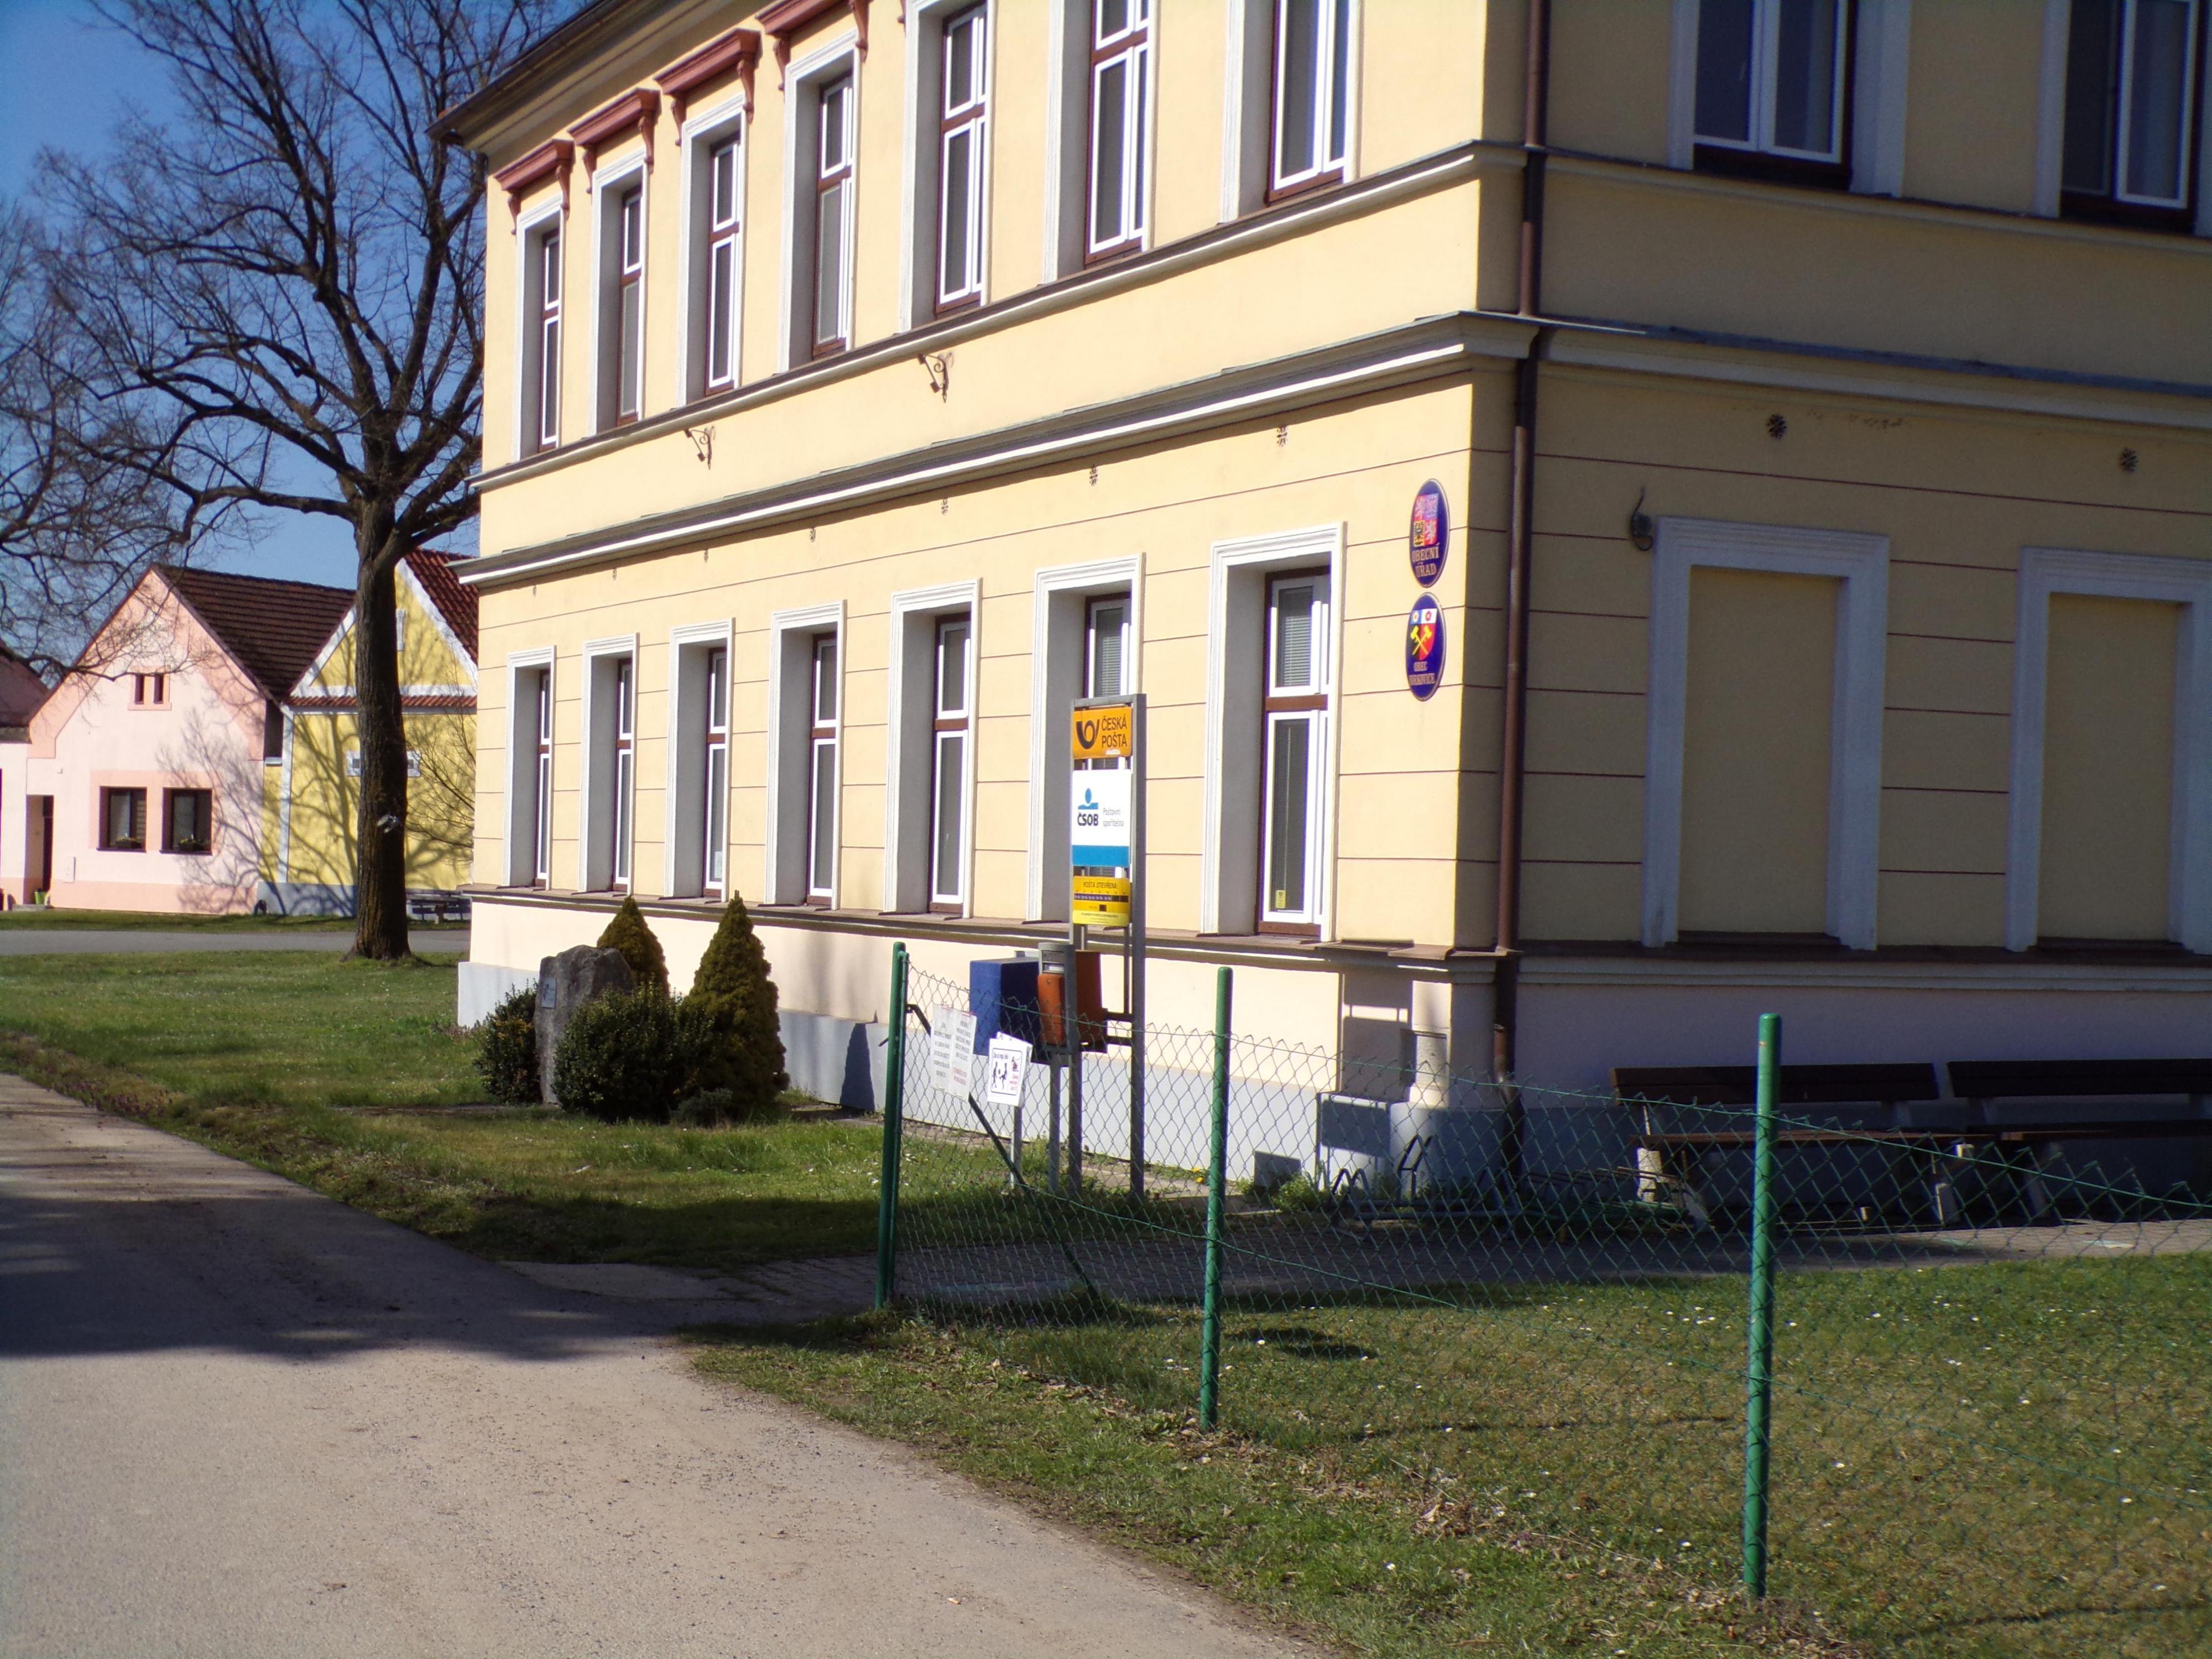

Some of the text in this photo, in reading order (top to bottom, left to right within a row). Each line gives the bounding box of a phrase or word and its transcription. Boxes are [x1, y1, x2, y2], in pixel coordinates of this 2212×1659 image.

[1412, 542, 1439, 562] OBECNÍ
[1416, 561, 1437, 577] ÚŘAD
[1414, 660, 1428, 672] OBEC
[1102, 714, 1127, 731] ČESKÁ
[1102, 732, 1128, 748] POŠTA
[1077, 811, 1099, 826] ČSOB
[1103, 807, 1121, 815] Poštovní
[1103, 818, 1124, 828] spořitelna
